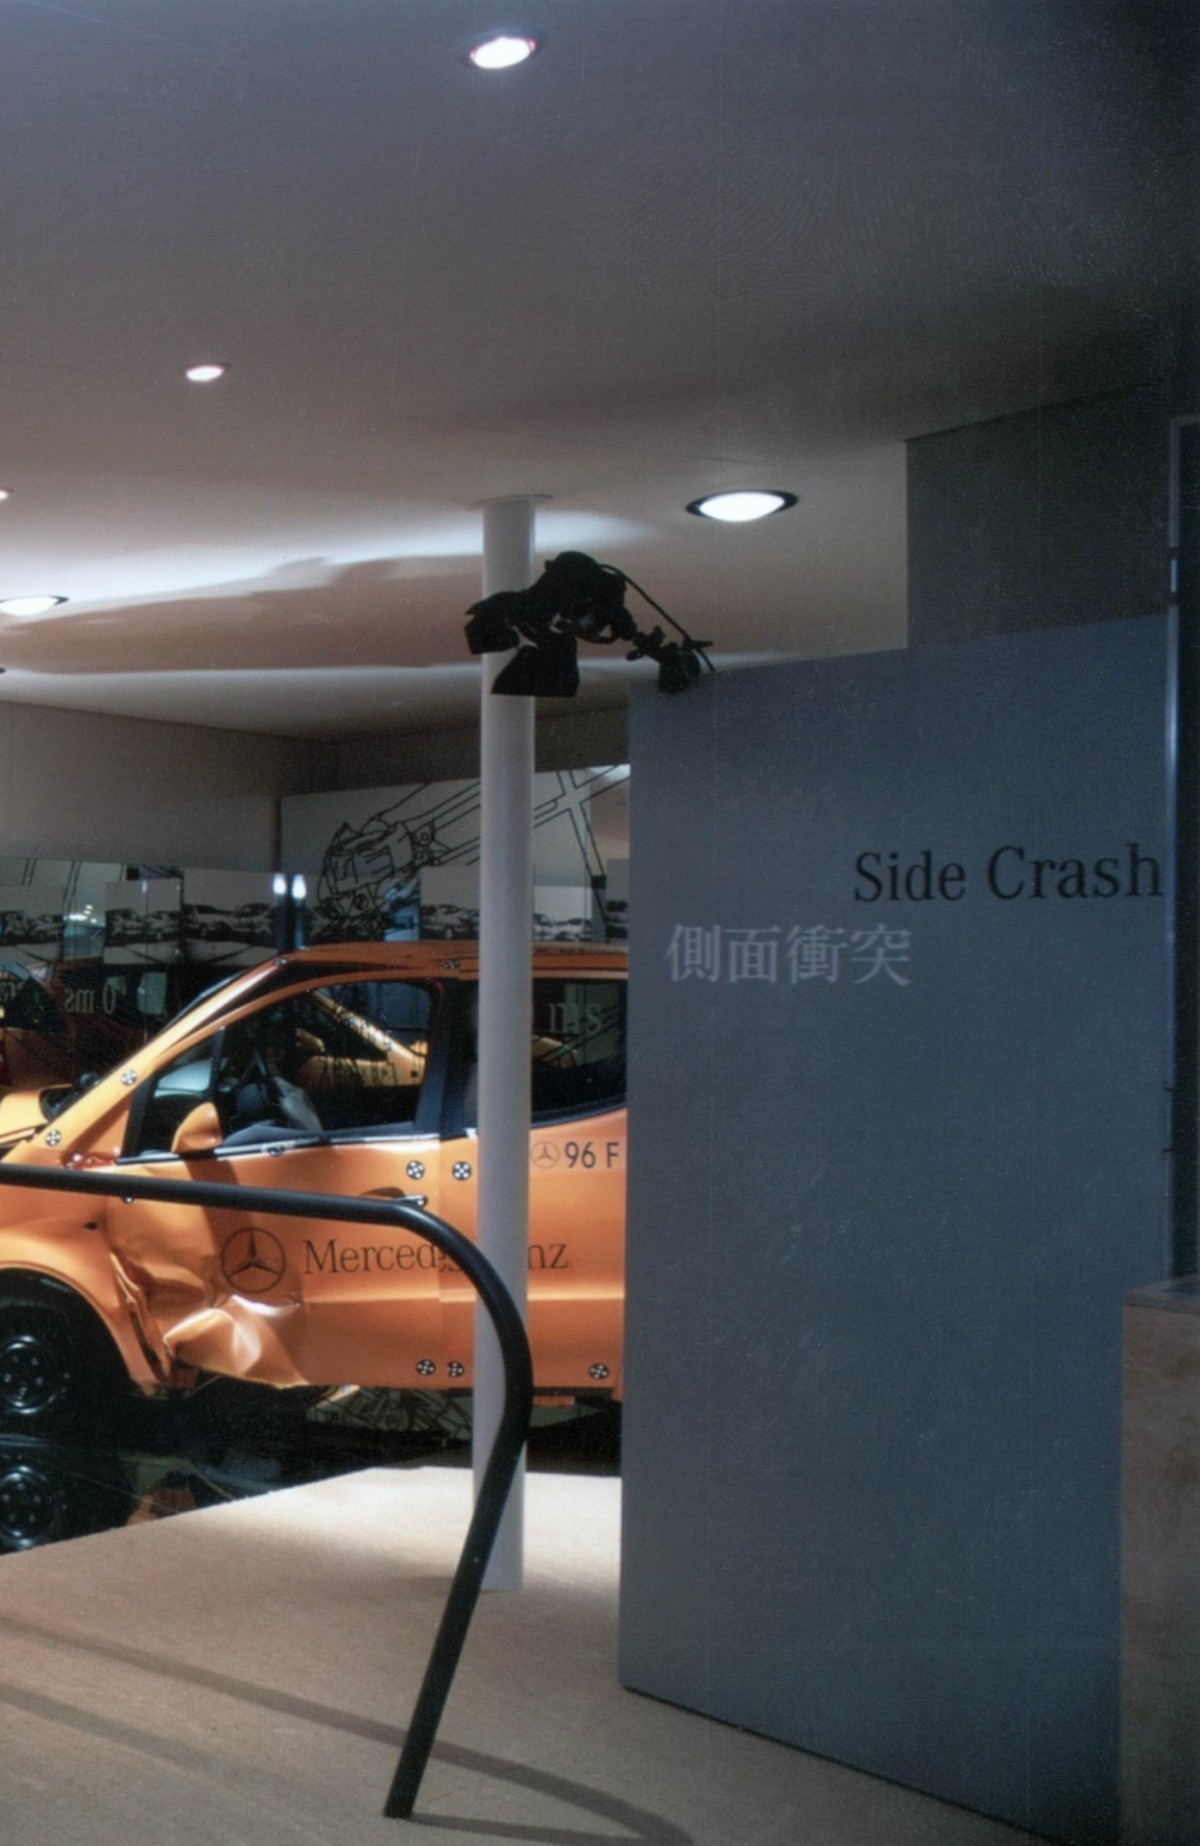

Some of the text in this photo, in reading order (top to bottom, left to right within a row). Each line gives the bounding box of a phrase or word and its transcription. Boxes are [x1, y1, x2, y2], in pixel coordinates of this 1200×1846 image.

[854, 842, 1163, 902] Side Crash
[664, 923, 913, 987] 側面衝突
[564, 1141, 621, 1169] 96 F
[303, 1239, 569, 1275] Mercednz
